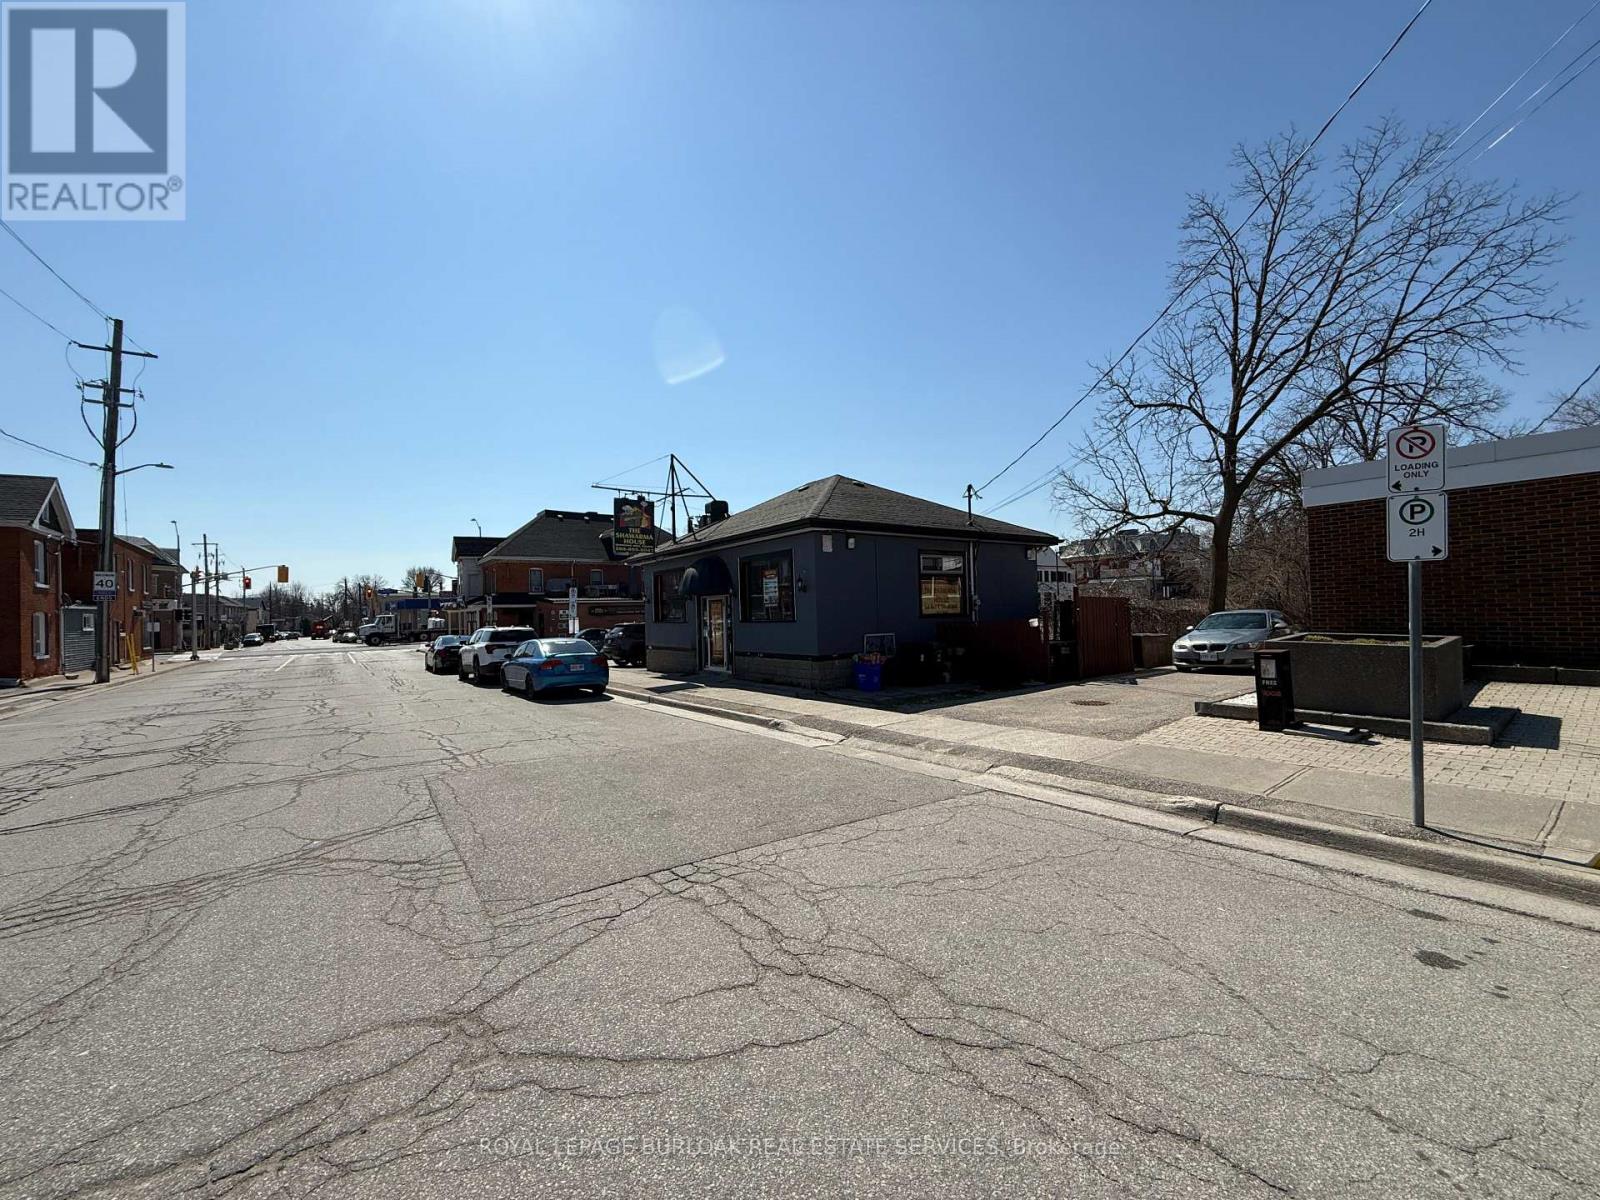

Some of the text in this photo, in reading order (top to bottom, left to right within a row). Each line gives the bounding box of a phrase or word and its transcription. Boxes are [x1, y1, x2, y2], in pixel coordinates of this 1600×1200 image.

[1394, 461, 1439, 472] LOADING
[1403, 470, 1430, 479] ONLY
[1408, 528, 1425, 537] 2H
[96, 580, 114, 588] 40
